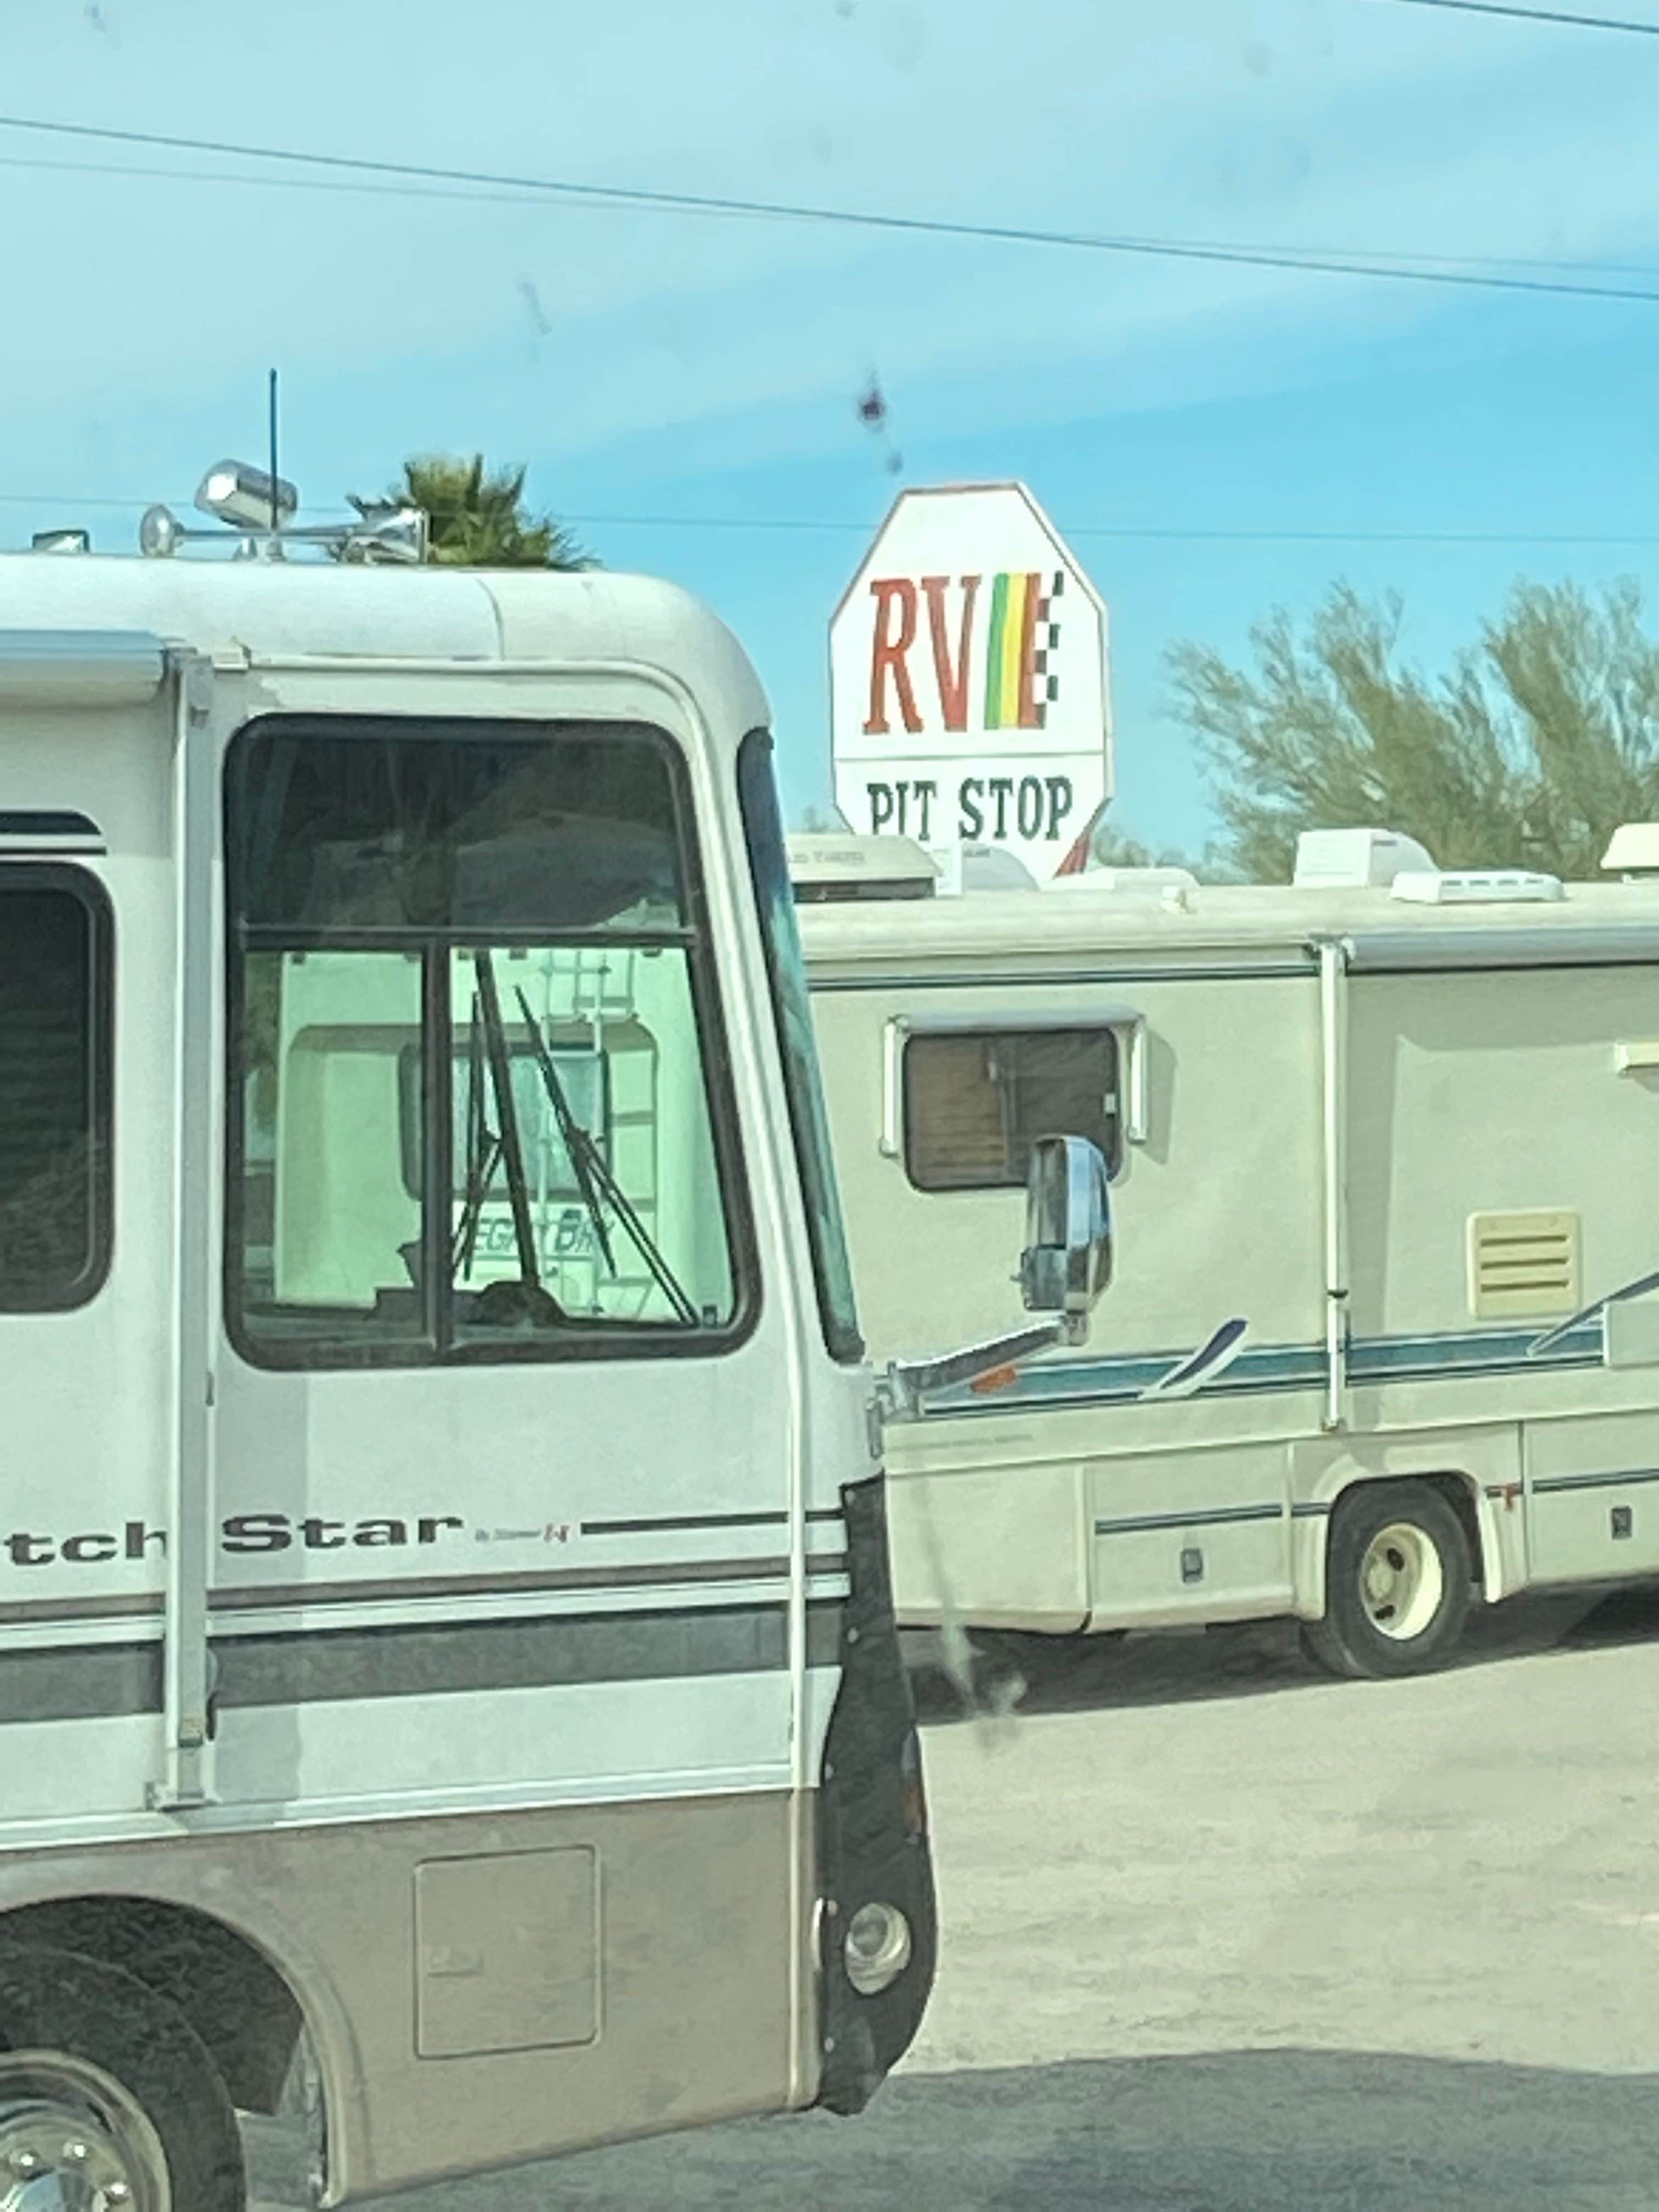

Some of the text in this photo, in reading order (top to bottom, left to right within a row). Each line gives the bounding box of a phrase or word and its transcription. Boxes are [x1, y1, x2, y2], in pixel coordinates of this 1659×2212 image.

[867, 775, 1073, 841] PIT STOP
[222, 1514, 464, 1552] Star
